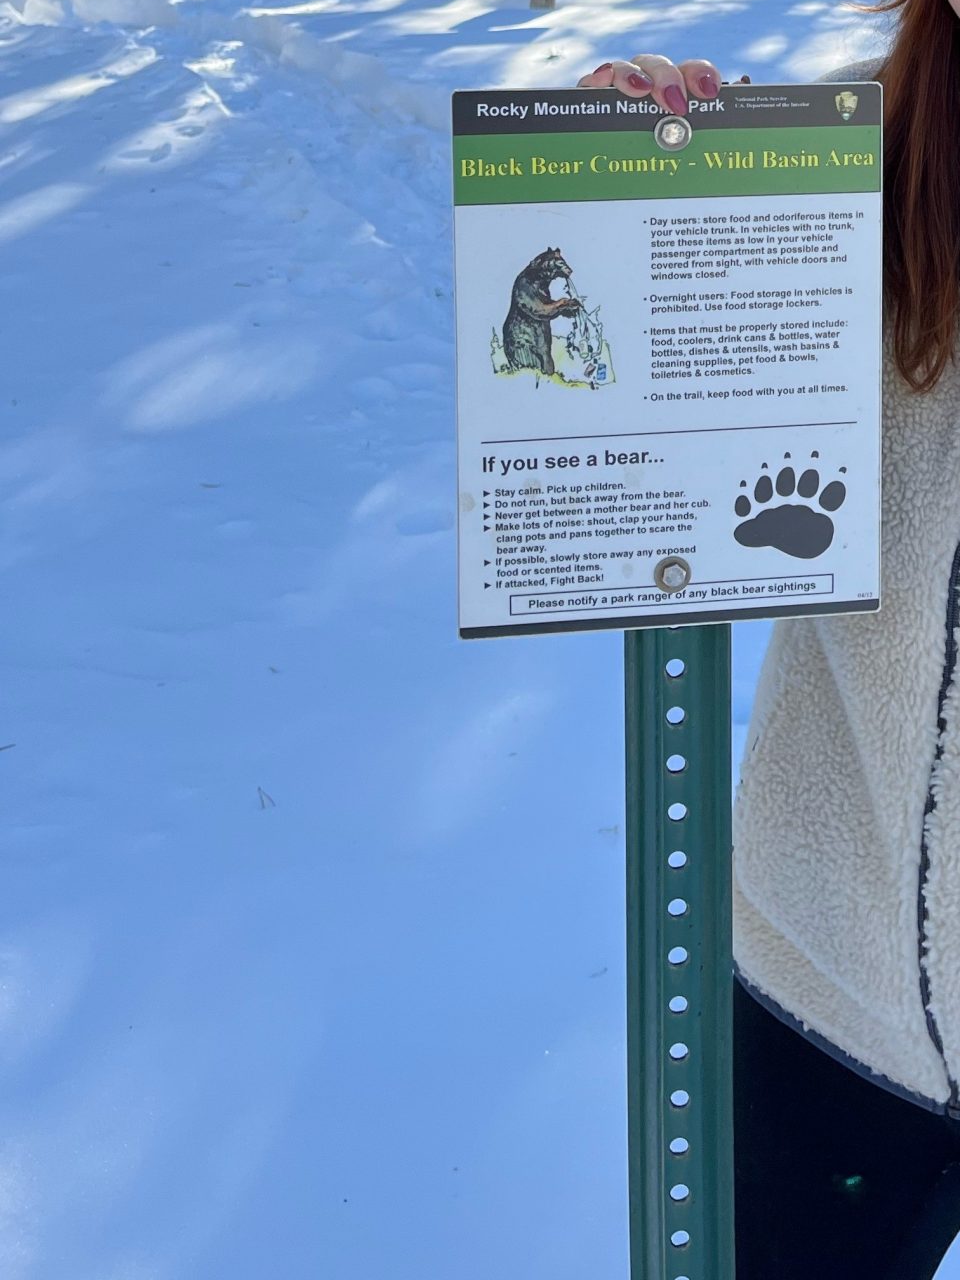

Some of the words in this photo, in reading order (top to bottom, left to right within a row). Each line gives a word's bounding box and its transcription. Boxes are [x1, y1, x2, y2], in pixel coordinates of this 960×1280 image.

[477, 103, 528, 119] Rocky
[534, 101, 611, 116] Mountain
[616, 100, 674, 114] Natio
[688, 99, 725, 114] Park
[461, 158, 523, 177] Black
[531, 157, 584, 175] Bear
[590, 155, 681, 176] Country
[704, 151, 754, 169] Wild
[763, 150, 819, 168] Basin
[825, 150, 874, 166] Area
[650, 217, 667, 227] Day
[702, 215, 727, 223] store
[729, 214, 750, 222] food
[753, 213, 770, 222] and
[772, 212, 825, 221] odoriferous
[828, 211, 852, 219] items
[855, 210, 863, 218] in
[650, 229, 672, 238] your
[674, 226, 708, 235] vehicle
[710, 225, 738, 234] trunk.
[740, 225, 749, 233] In
[752, 224, 790, 232] vehicles
[792, 222, 811, 231] with
[828, 221, 854, 230] trunk,
[650, 292, 696, 303] Overnight
[730, 290, 754, 299] Food
[756, 290, 791, 299] storage
[794, 288, 802, 296] in
[805, 287, 842, 296] vehicles
[845, 286, 852, 294] is
[651, 303, 702, 315] prohibited.
[704, 302, 722, 311] Use
[724, 301, 746, 310] food
[748, 301, 783, 310] storage
[786, 298, 821, 307] lockers.
[650, 327, 675, 335] Items
[678, 325, 696, 334] that
[699, 324, 722, 333] must
[725, 323, 736, 331] be
[739, 322, 777, 333] properly
[780, 320, 809, 329] stored
[812, 319, 847, 328] include:
[651, 337, 675, 346] food,
[677, 336, 715, 345] coolers,
[717, 334, 741, 343] drink
[768, 332, 775, 340] &
[778, 331, 812, 340] bottles,
[814, 330, 840, 338] water
[649, 392, 664, 401] On
[666, 392, 681, 400] the
[683, 390, 704, 399] trail,
[707, 390, 729, 399] keep
[732, 388, 752, 397] food
[755, 387, 774, 395] with
[777, 388, 794, 396] you
[808, 384, 818, 393] all
[820, 384, 848, 392] times.
[482, 456, 495, 472] If
[500, 458, 537, 475] you
[544, 456, 579, 468] see
[586, 455, 597, 466] a
[604, 449, 663, 465] bear...
[494, 488, 515, 498] Stay
[518, 486, 544, 495] calm.
[546, 484, 567, 493] Pick
[570, 485, 582, 494] up
[584, 482, 626, 491] children.
[494, 499, 508, 508] Do
[510, 499, 526, 507] not
[550, 496, 566, 505] but
[568, 494, 591, 503] back
[594, 495, 618, 503] away
[620, 492, 642, 500] from
[645, 490, 660, 499] the
[663, 489, 685, 498] bear.
[495, 511, 523, 519] Never
[525, 509, 540, 520] get
[543, 508, 582, 516] between
[593, 504, 628, 513] mother
[630, 503, 651, 511] bear
[653, 501, 670, 510] and
[673, 500, 689, 509] her
[690, 499, 710, 507] cub.
[495, 557, 502, 565] If
[504, 555, 547, 567] possible,
[550, 552, 580, 562] slowly
[582, 552, 607, 560] store
[610, 551, 633, 559] away
[636, 549, 653, 557] any
[656, 544, 696, 556] exposed
[496, 567, 518, 577] food
[533, 564, 571, 574] scented
[574, 563, 603, 572] items.
[496, 580, 502, 588] If
[504, 577, 547, 588] attacked,
[550, 575, 574, 586] Fight
[577, 573, 603, 583] Back!
[528, 599, 564, 608] Please
[567, 595, 598, 606] notify
[610, 592, 634, 605] park
[638, 594, 673, 602] ranger
[689, 591, 708, 599] any
[711, 588, 738, 596] black
[742, 586, 765, 594] bear
[768, 582, 816, 593] sightings
